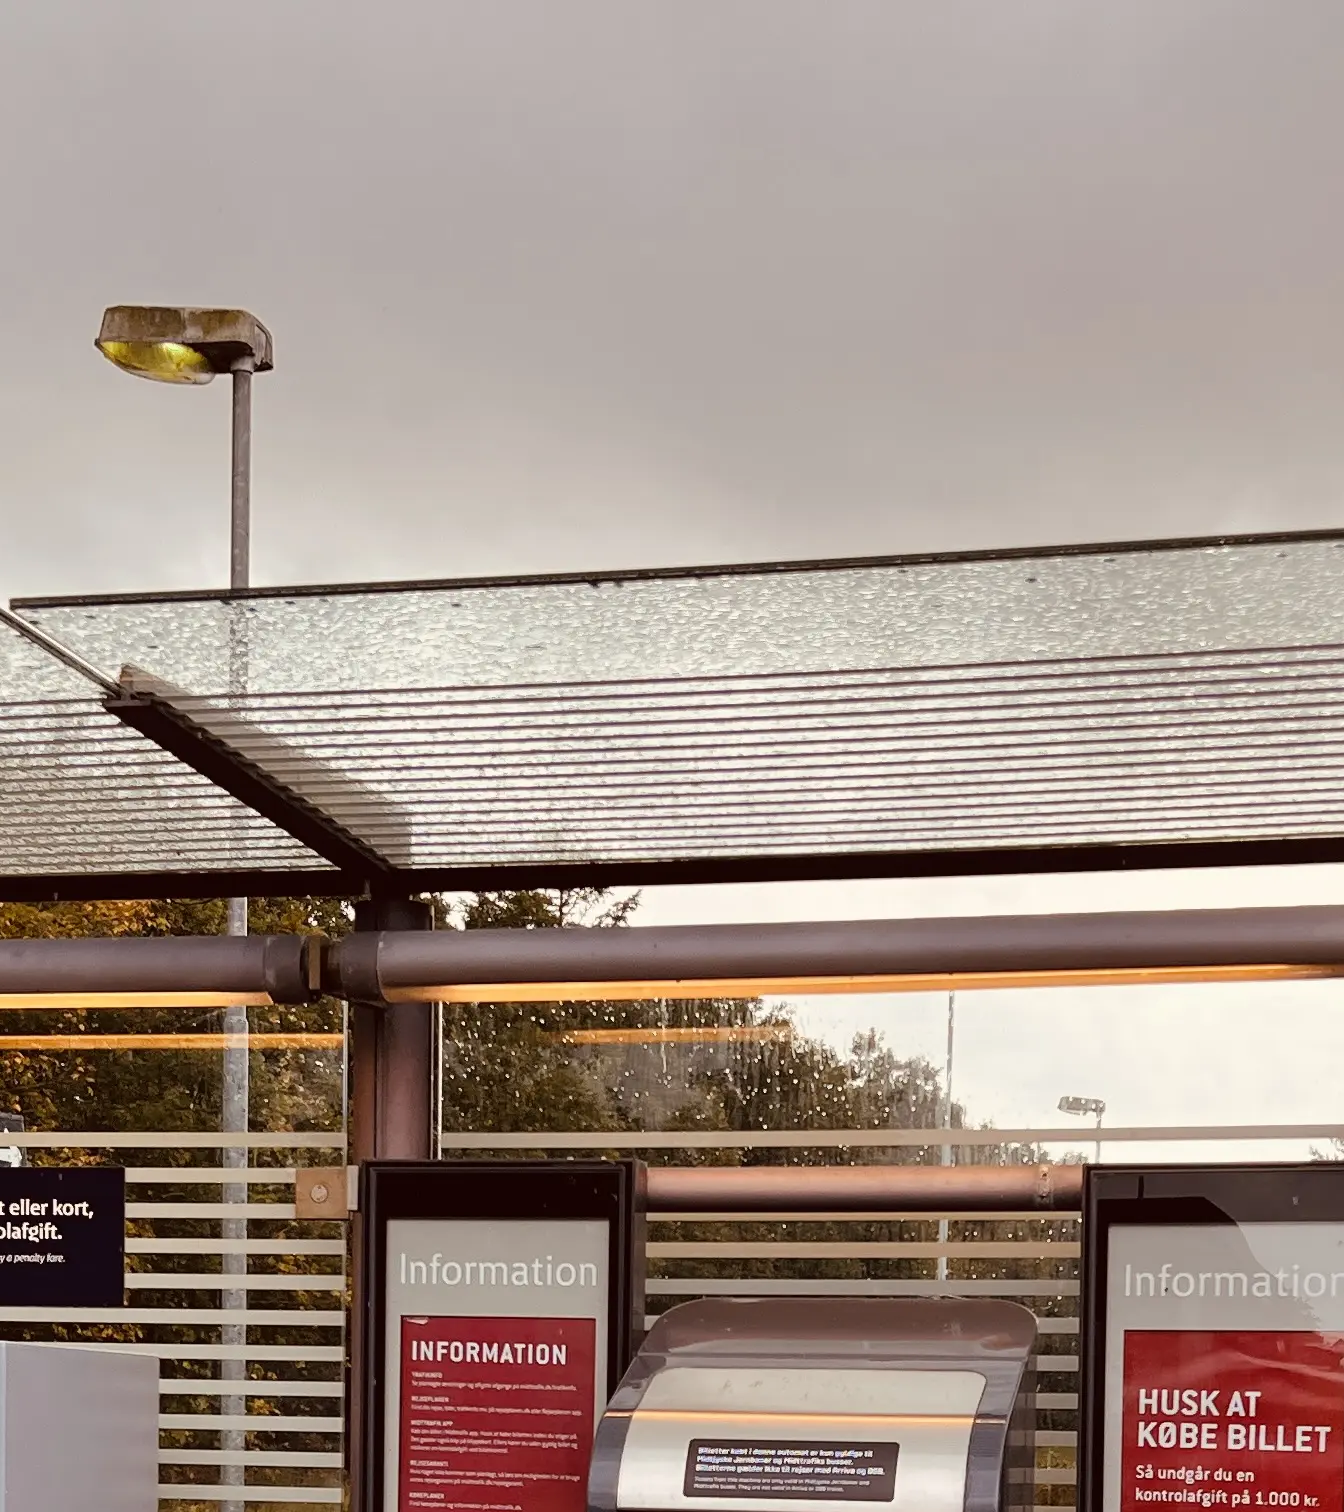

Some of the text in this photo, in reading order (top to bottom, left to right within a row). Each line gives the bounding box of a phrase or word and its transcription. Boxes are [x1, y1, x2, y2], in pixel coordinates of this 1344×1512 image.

[9, 1198, 48, 1216] eller
[52, 1198, 94, 1219] kort,
[399, 1252, 598, 1286] Information
[410, 1340, 567, 1366] INFORMATION
[1137, 1389, 1261, 1417] HUSK AT
[1136, 1420, 1331, 1453] KØBE BILLET
[1136, 1464, 1255, 1484] Så undgår du en
[1135, 1486, 1320, 1507] kontrolafgift på 1.000 kr.
